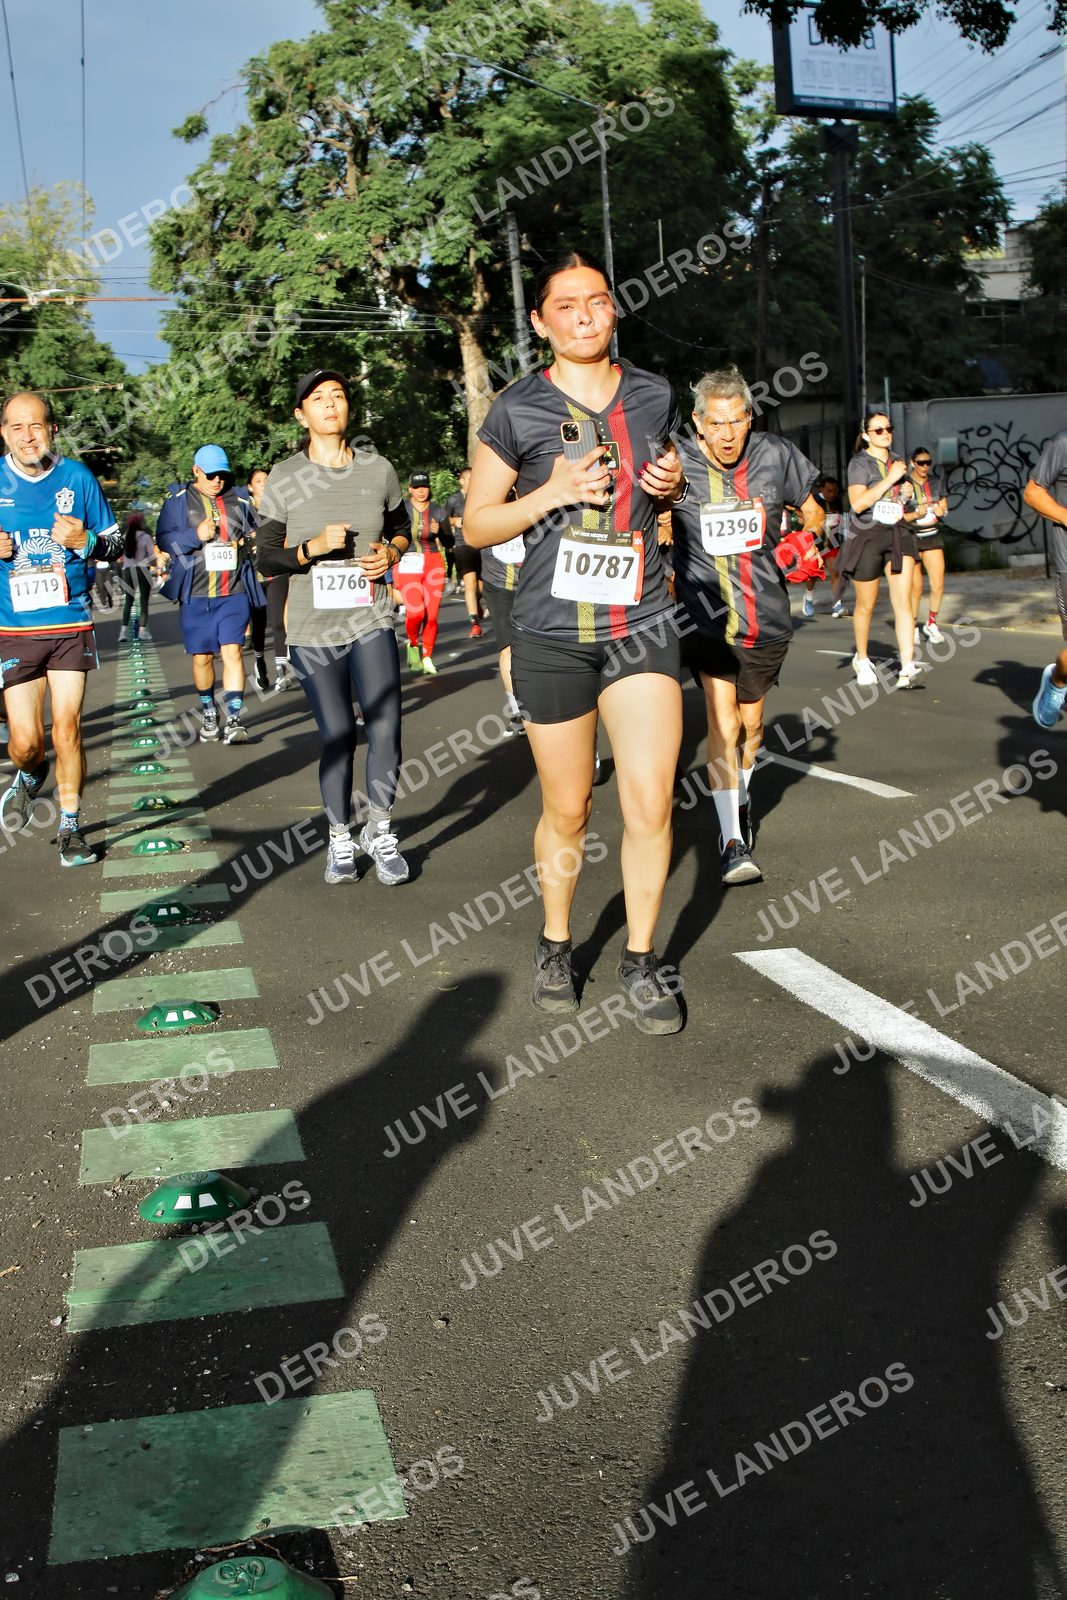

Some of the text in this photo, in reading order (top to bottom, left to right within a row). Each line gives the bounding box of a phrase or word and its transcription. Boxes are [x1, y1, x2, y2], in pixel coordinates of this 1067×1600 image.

[958, 421, 1013, 442] TOY
[28, 528, 50, 538] DE
[705, 517, 758, 537] 12396
[211, 551, 233, 560] 5405
[563, 550, 634, 579] 10787
[14, 578, 59, 596] 11719
[317, 574, 367, 590] 12766
